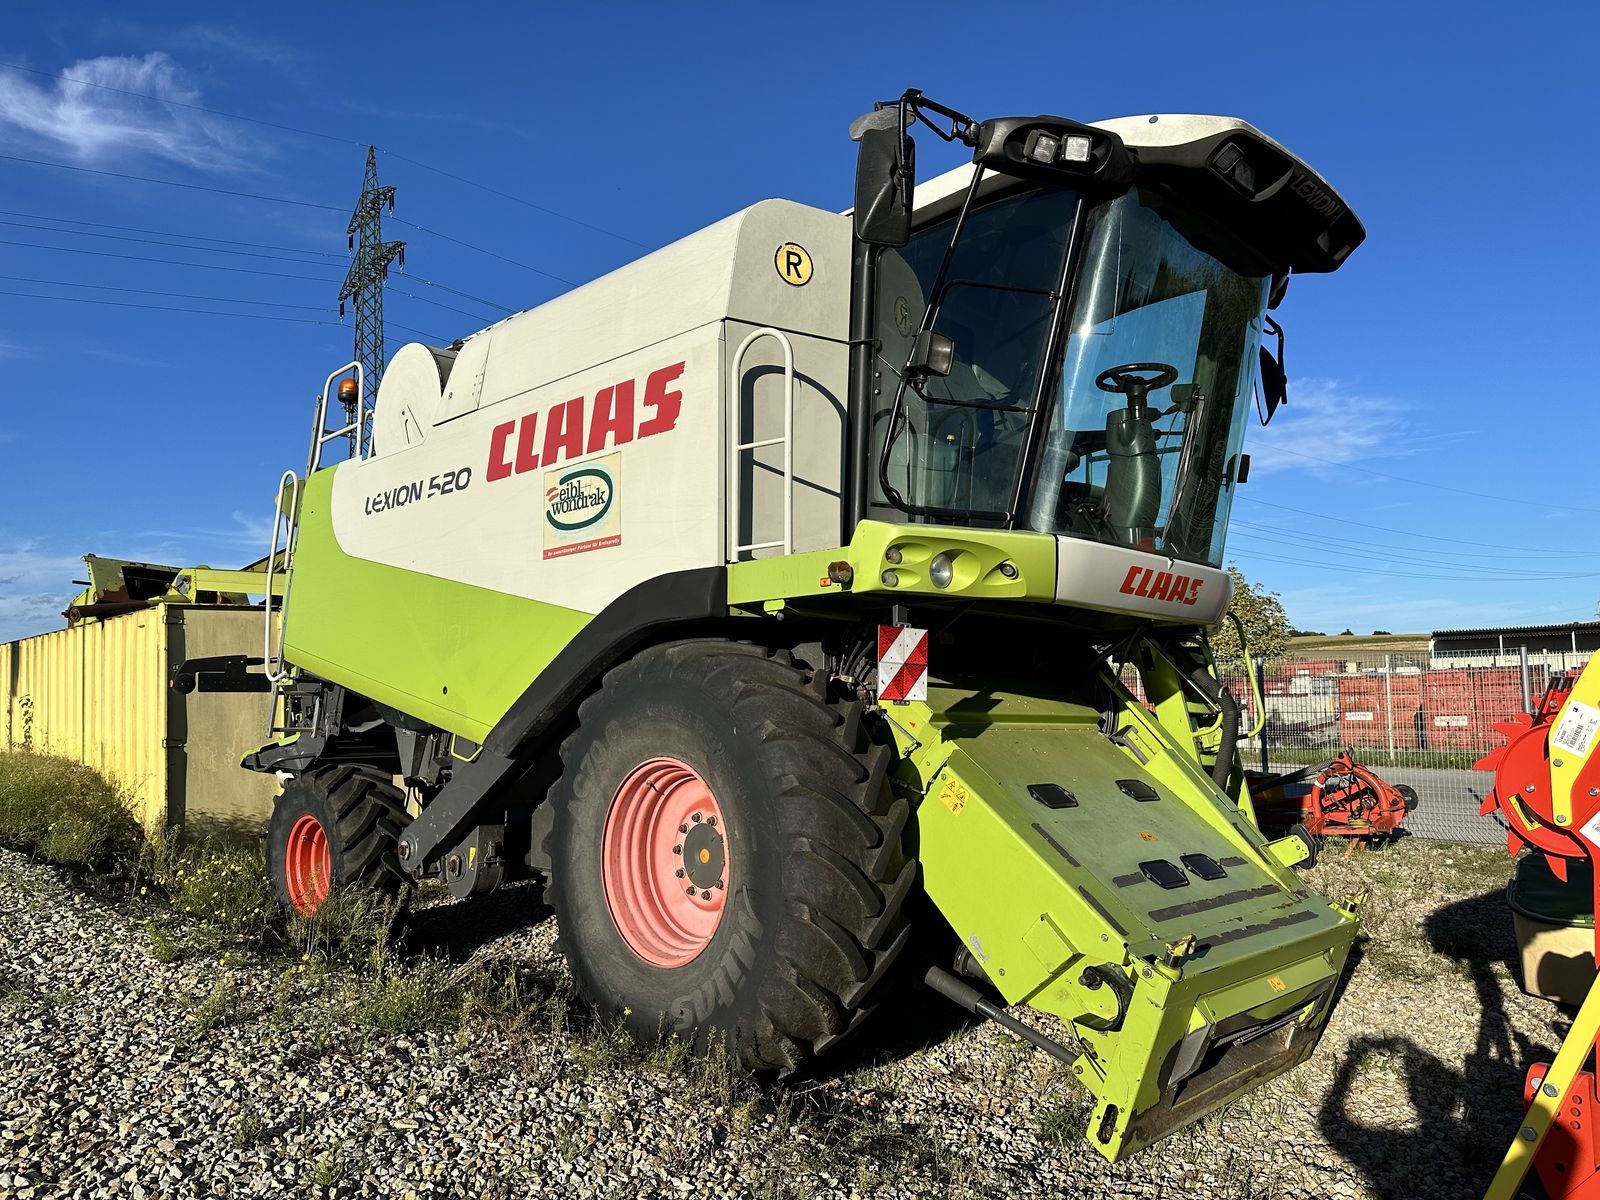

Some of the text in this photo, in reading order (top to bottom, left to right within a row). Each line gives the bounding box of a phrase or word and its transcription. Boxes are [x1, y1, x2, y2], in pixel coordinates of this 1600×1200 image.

[1290, 174, 1340, 217] LEXION
[786, 250, 803, 279] R
[486, 361, 686, 483] CLAAS
[365, 467, 472, 516] LEXION 520
[551, 487, 606, 516] wondrak
[1119, 565, 1204, 606] CLAAS
